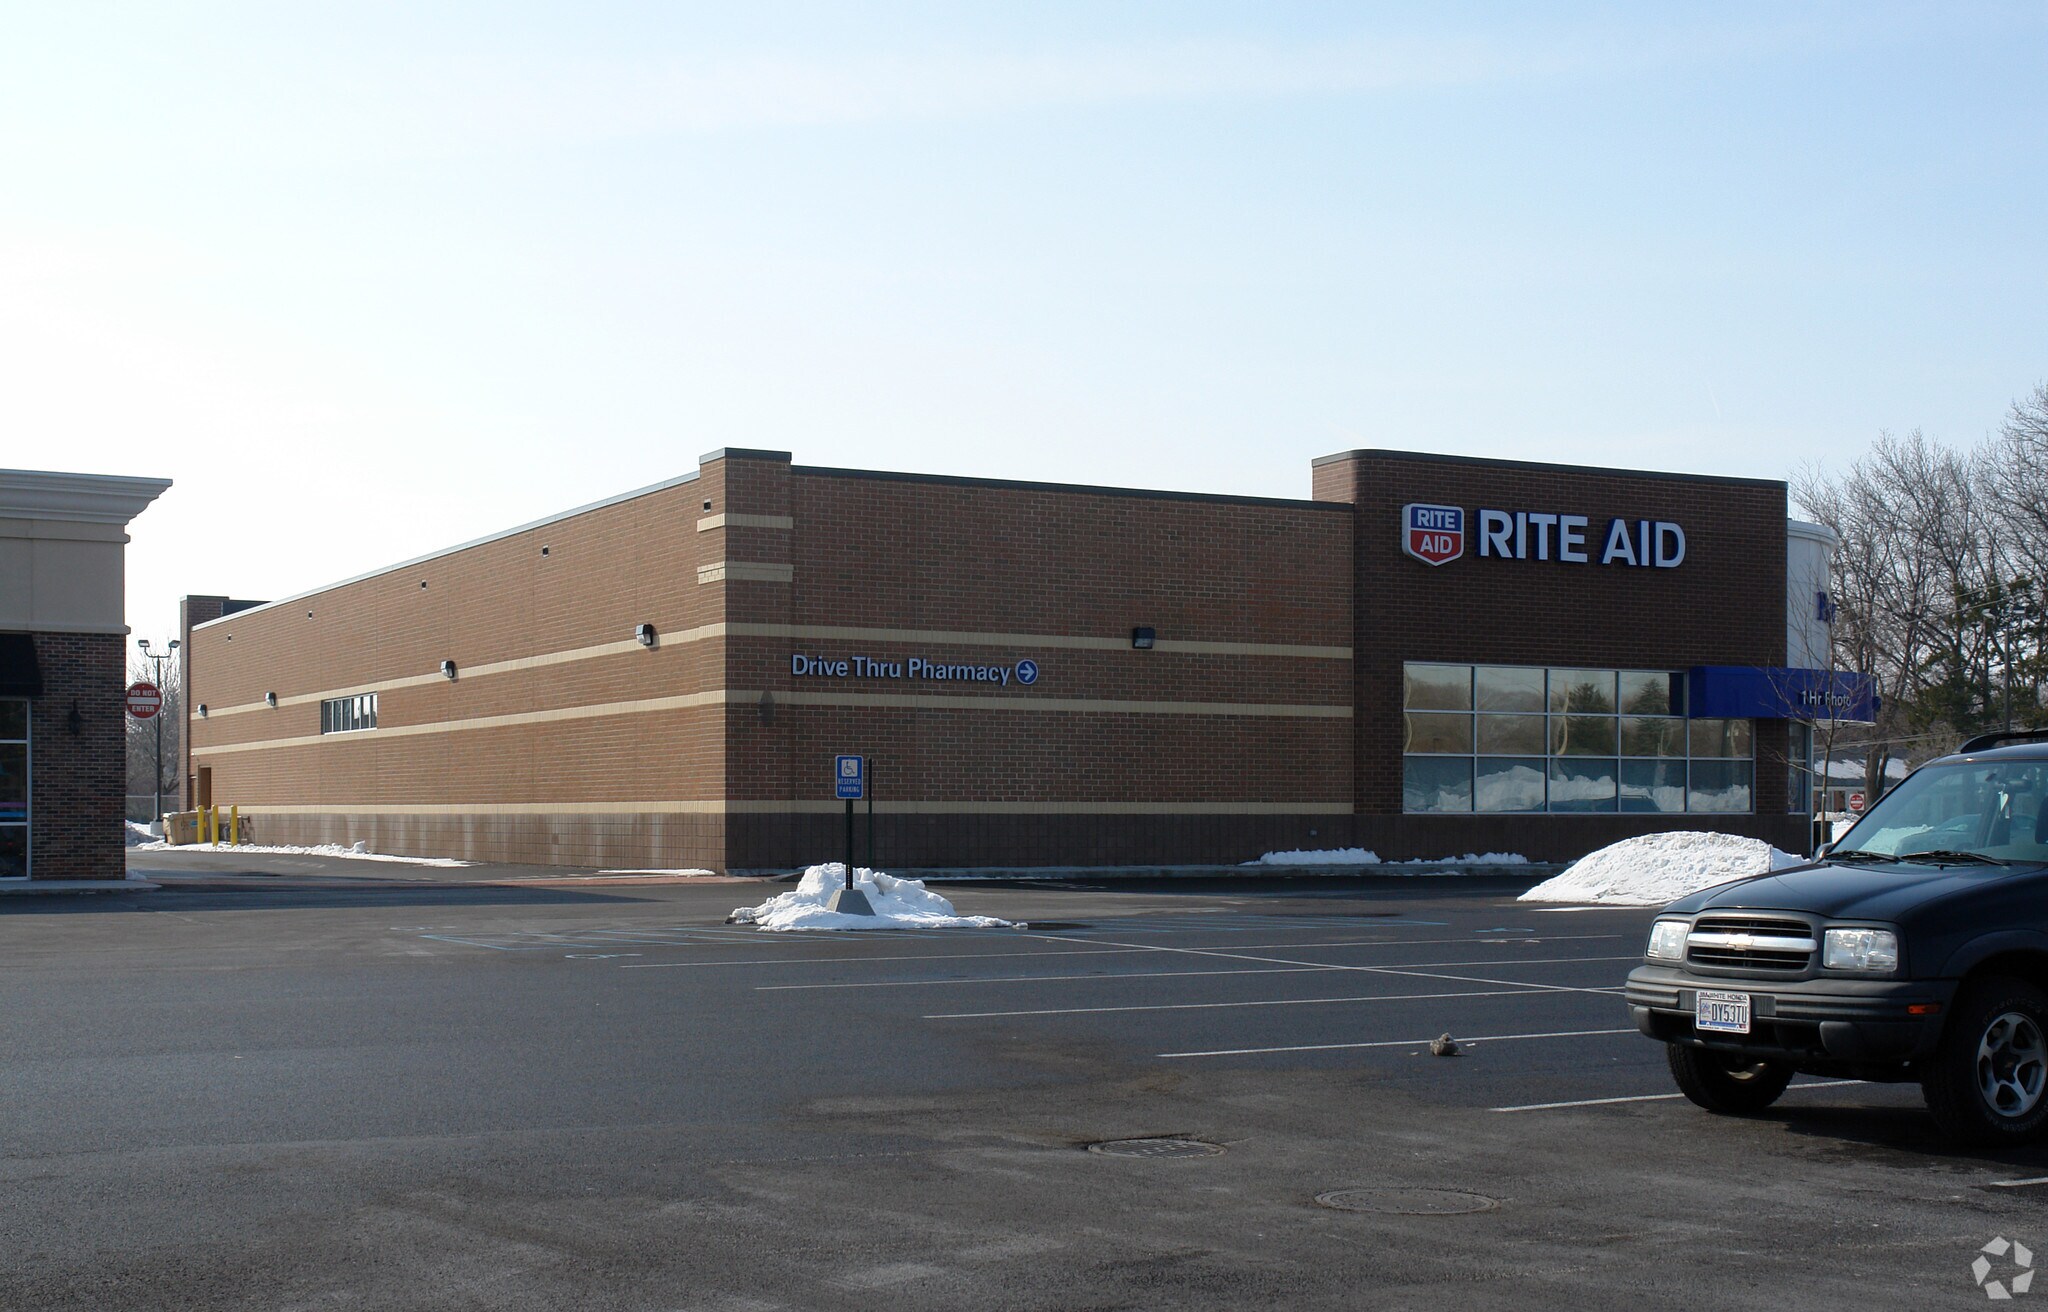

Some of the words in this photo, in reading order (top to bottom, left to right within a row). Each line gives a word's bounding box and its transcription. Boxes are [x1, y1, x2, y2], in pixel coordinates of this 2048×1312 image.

[1417, 509, 1456, 529] RITE
[1419, 534, 1453, 554] AID
[1478, 509, 1589, 563] RITE
[1601, 518, 1686, 568] AID
[792, 654, 848, 677] Drive
[852, 656, 901, 679] Thru
[908, 658, 1011, 687] Pharmacy
[1801, 690, 1807, 705] 1
[1809, 690, 1822, 705] Hr
[839, 785, 860, 793] PARKING
[1711, 1003, 1748, 1024] DY53TU
